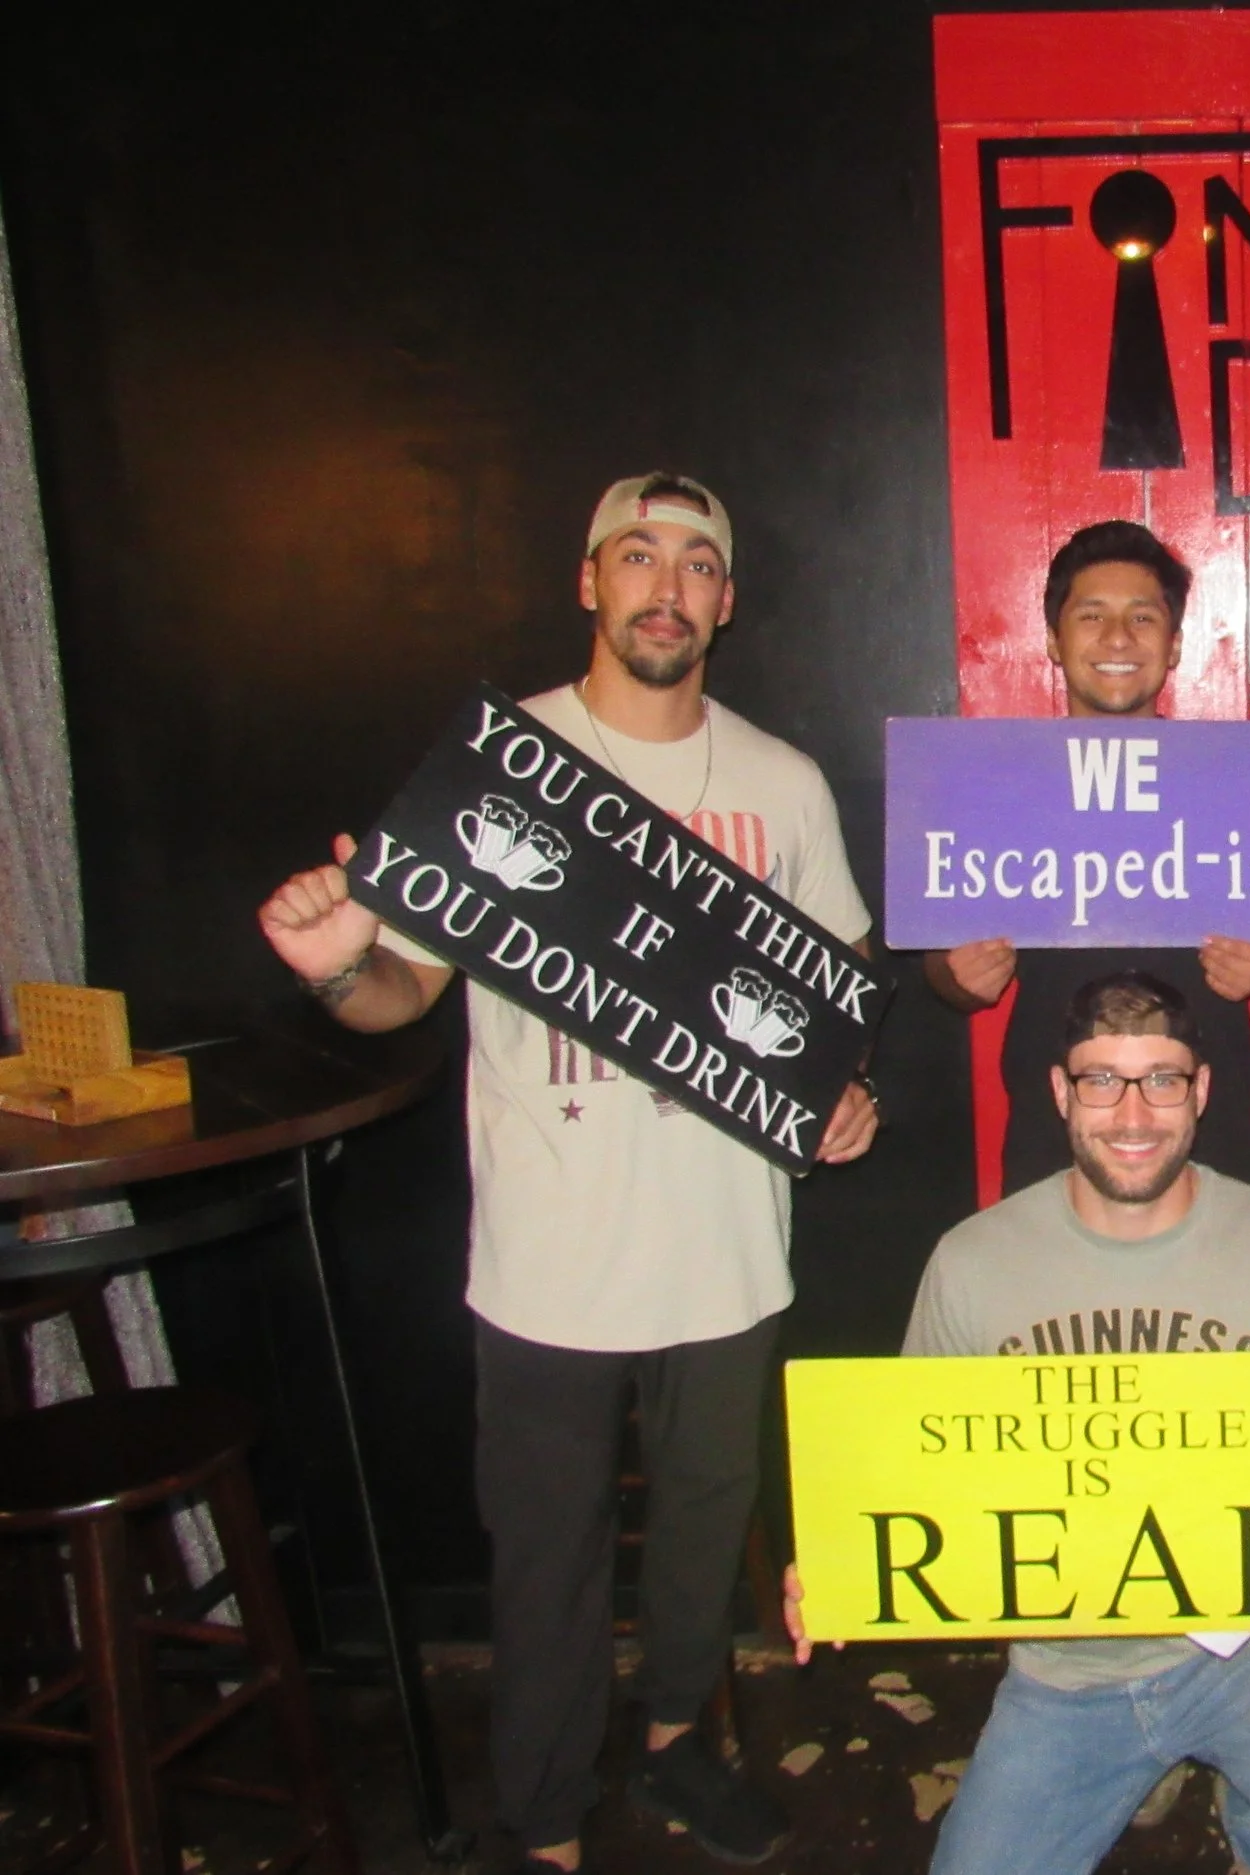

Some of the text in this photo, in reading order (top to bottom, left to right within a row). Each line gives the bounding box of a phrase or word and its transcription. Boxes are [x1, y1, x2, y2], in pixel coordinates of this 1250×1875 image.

[1067, 738, 1159, 811] WE
[466, 701, 588, 806] YOU
[584, 792, 734, 915] CAN'T
[732, 893, 878, 1025] THINK
[612, 903, 675, 962] IF
[363, 830, 497, 939] YOU
[487, 916, 657, 1047] DON'T
[652, 1023, 818, 1158] DRINK
[1022, 1364, 1143, 1405] THE
[920, 1409, 1249, 1455] STRUGGLE
[1064, 1457, 1112, 1498] IS
